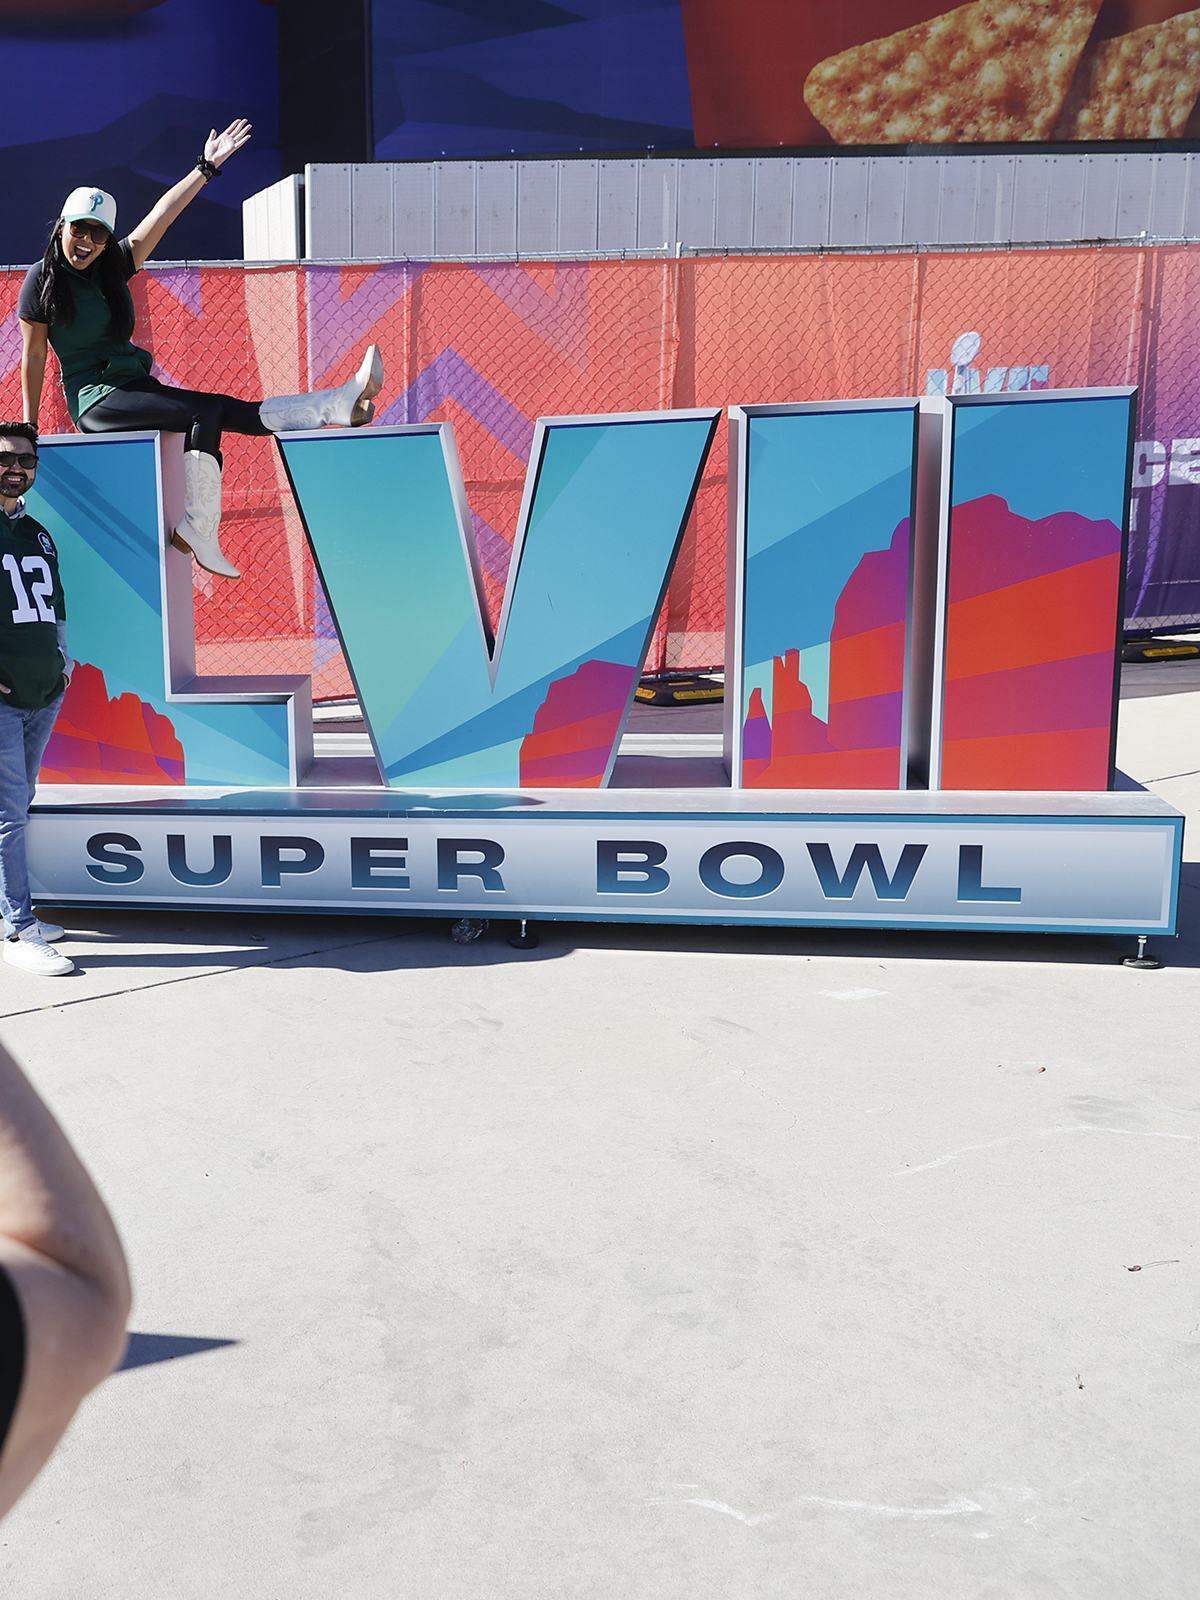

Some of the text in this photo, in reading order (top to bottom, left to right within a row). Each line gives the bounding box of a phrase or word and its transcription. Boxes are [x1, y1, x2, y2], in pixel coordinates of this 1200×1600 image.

[90, 193, 105, 212] P
[1, 553, 58, 625] 12
[34, 386, 1138, 793] LVII
[85, 832, 1022, 904] SUPER BOWL
